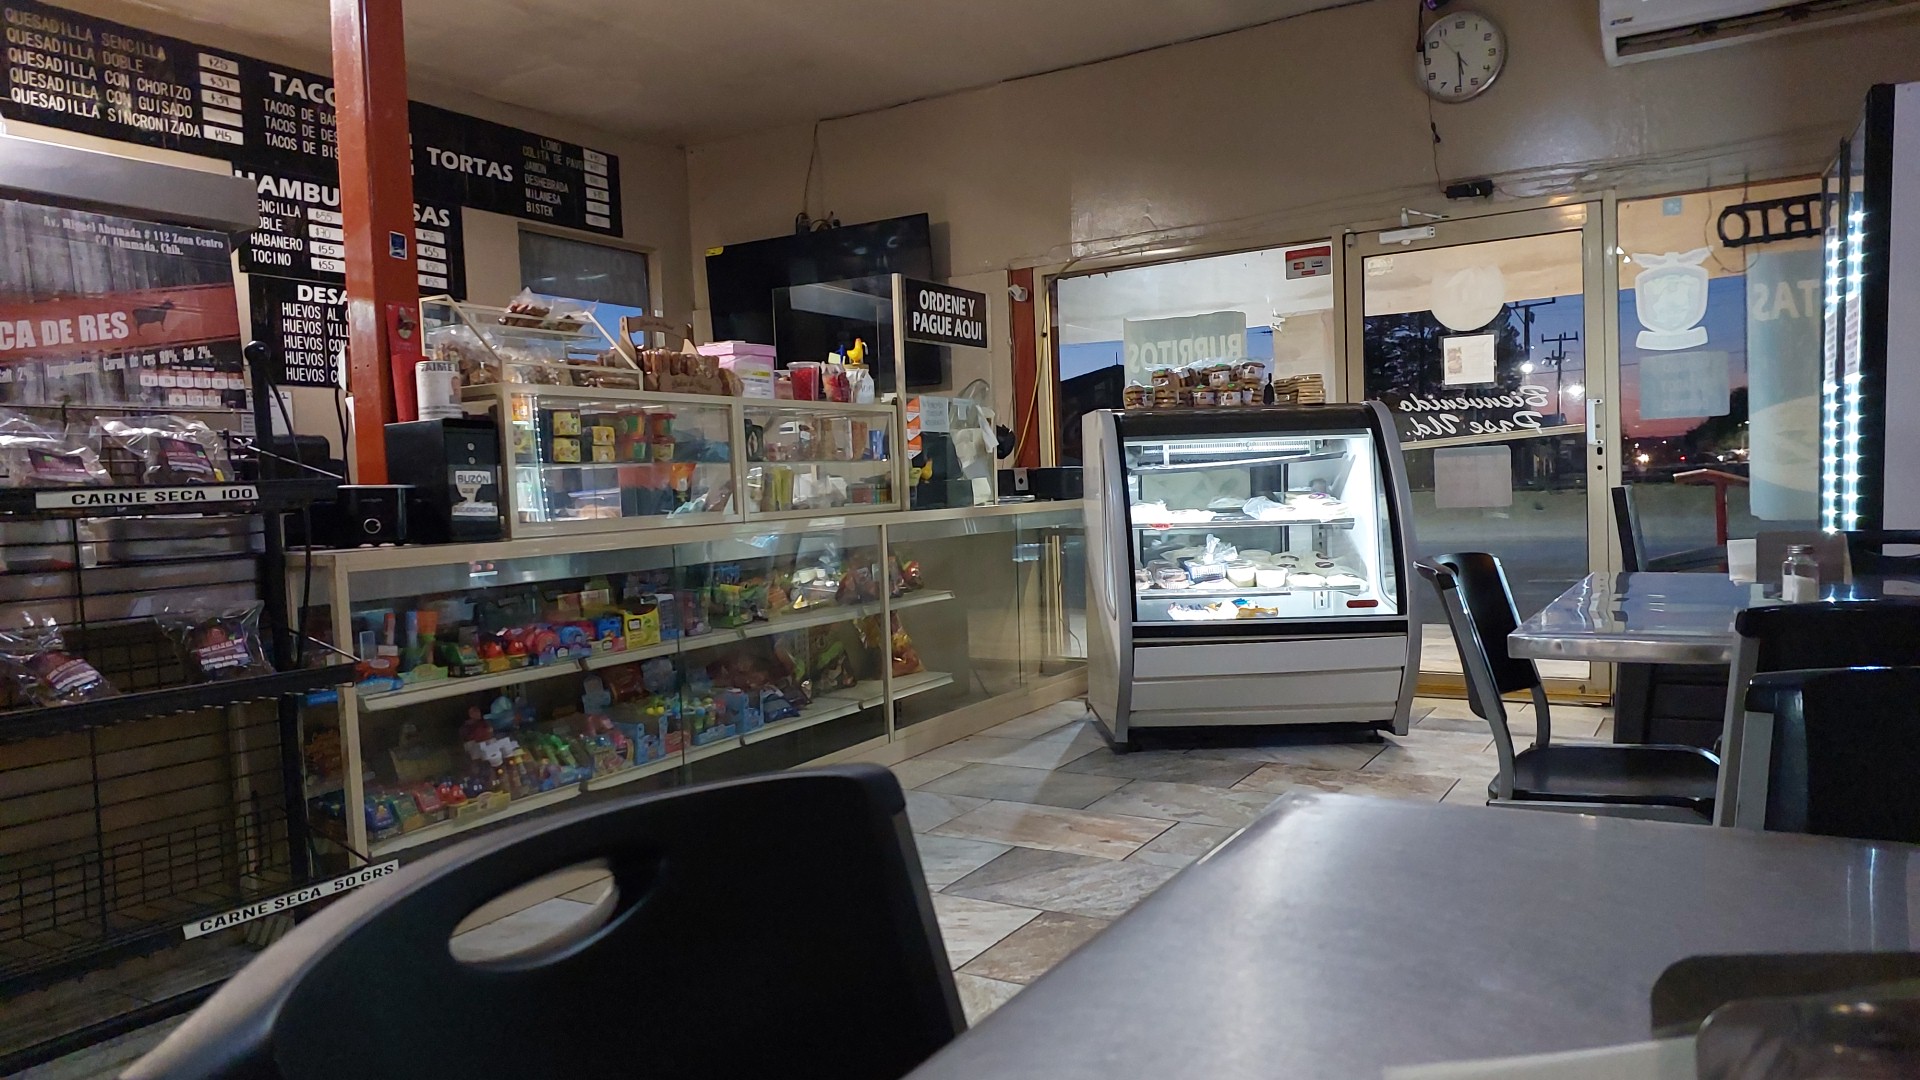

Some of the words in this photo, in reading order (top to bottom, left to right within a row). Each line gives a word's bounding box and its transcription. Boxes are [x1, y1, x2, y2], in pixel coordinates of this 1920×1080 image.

[5, 7, 94, 42] QUESADILLA
[101, 32, 166, 61] SENCILLA
[1483, 32, 1492, 42] 2
[6, 27, 95, 62] QUESADILLA
[102, 51, 144, 73] DOBLE
[1429, 41, 1439, 50] 10
[8, 47, 97, 81] QUESADILLA
[104, 70, 130, 89] CON
[137, 77, 192, 101] CHORIZO
[1483, 64, 1491, 72] 4
[1440, 81, 1448, 89] 7
[1470, 77, 1479, 86] 5
[10, 67, 98, 101] QUESADILLA
[106, 89, 132, 109] CON
[138, 95, 193, 119] GUISADO
[11, 87, 101, 119] QUESADILLA
[107, 107, 201, 138] SINCRONIZADA
[263, 98, 297, 118] TACOS
[301, 107, 315, 122] DE
[264, 115, 297, 134] TACOS
[301, 124, 316, 139] DE
[265, 132, 298, 151] TACOS
[302, 140, 317, 155] DE
[426, 146, 514, 182] TORTAS
[526, 201, 554, 217] BISTEK
[98, 222, 142, 239] Ahumada
[153, 230, 171, 242] 112
[172, 233, 194, 246] Zona
[195, 236, 224, 249] Centro
[250, 232, 304, 251] HABANERO
[160, 243, 184, 256] Chih.
[251, 248, 292, 267] TOCINO
[281, 301, 321, 320] HUEVOS
[327, 307, 340, 321] AL
[919, 289, 966, 317] ORDENE
[967, 298, 976, 318] Y
[40, 318, 74, 346] DE
[78, 311, 129, 342] RES
[282, 318, 322, 336] HUEVOS
[912, 311, 953, 336] PAGUE
[953, 318, 982, 341] AQUI
[283, 334, 323, 352] HUEVOS
[285, 350, 325, 367] HUEVOS
[286, 366, 325, 383] HUEVOS
[457, 473, 489, 484] BUZÓN
[71, 492, 147, 506] CARNE
[154, 489, 206, 502] SECA
[222, 487, 253, 500] 100
[199, 903, 268, 933] CARNE
[273, 887, 322, 910] SECA
[333, 876, 356, 892] 50
[360, 864, 394, 882] GRS
